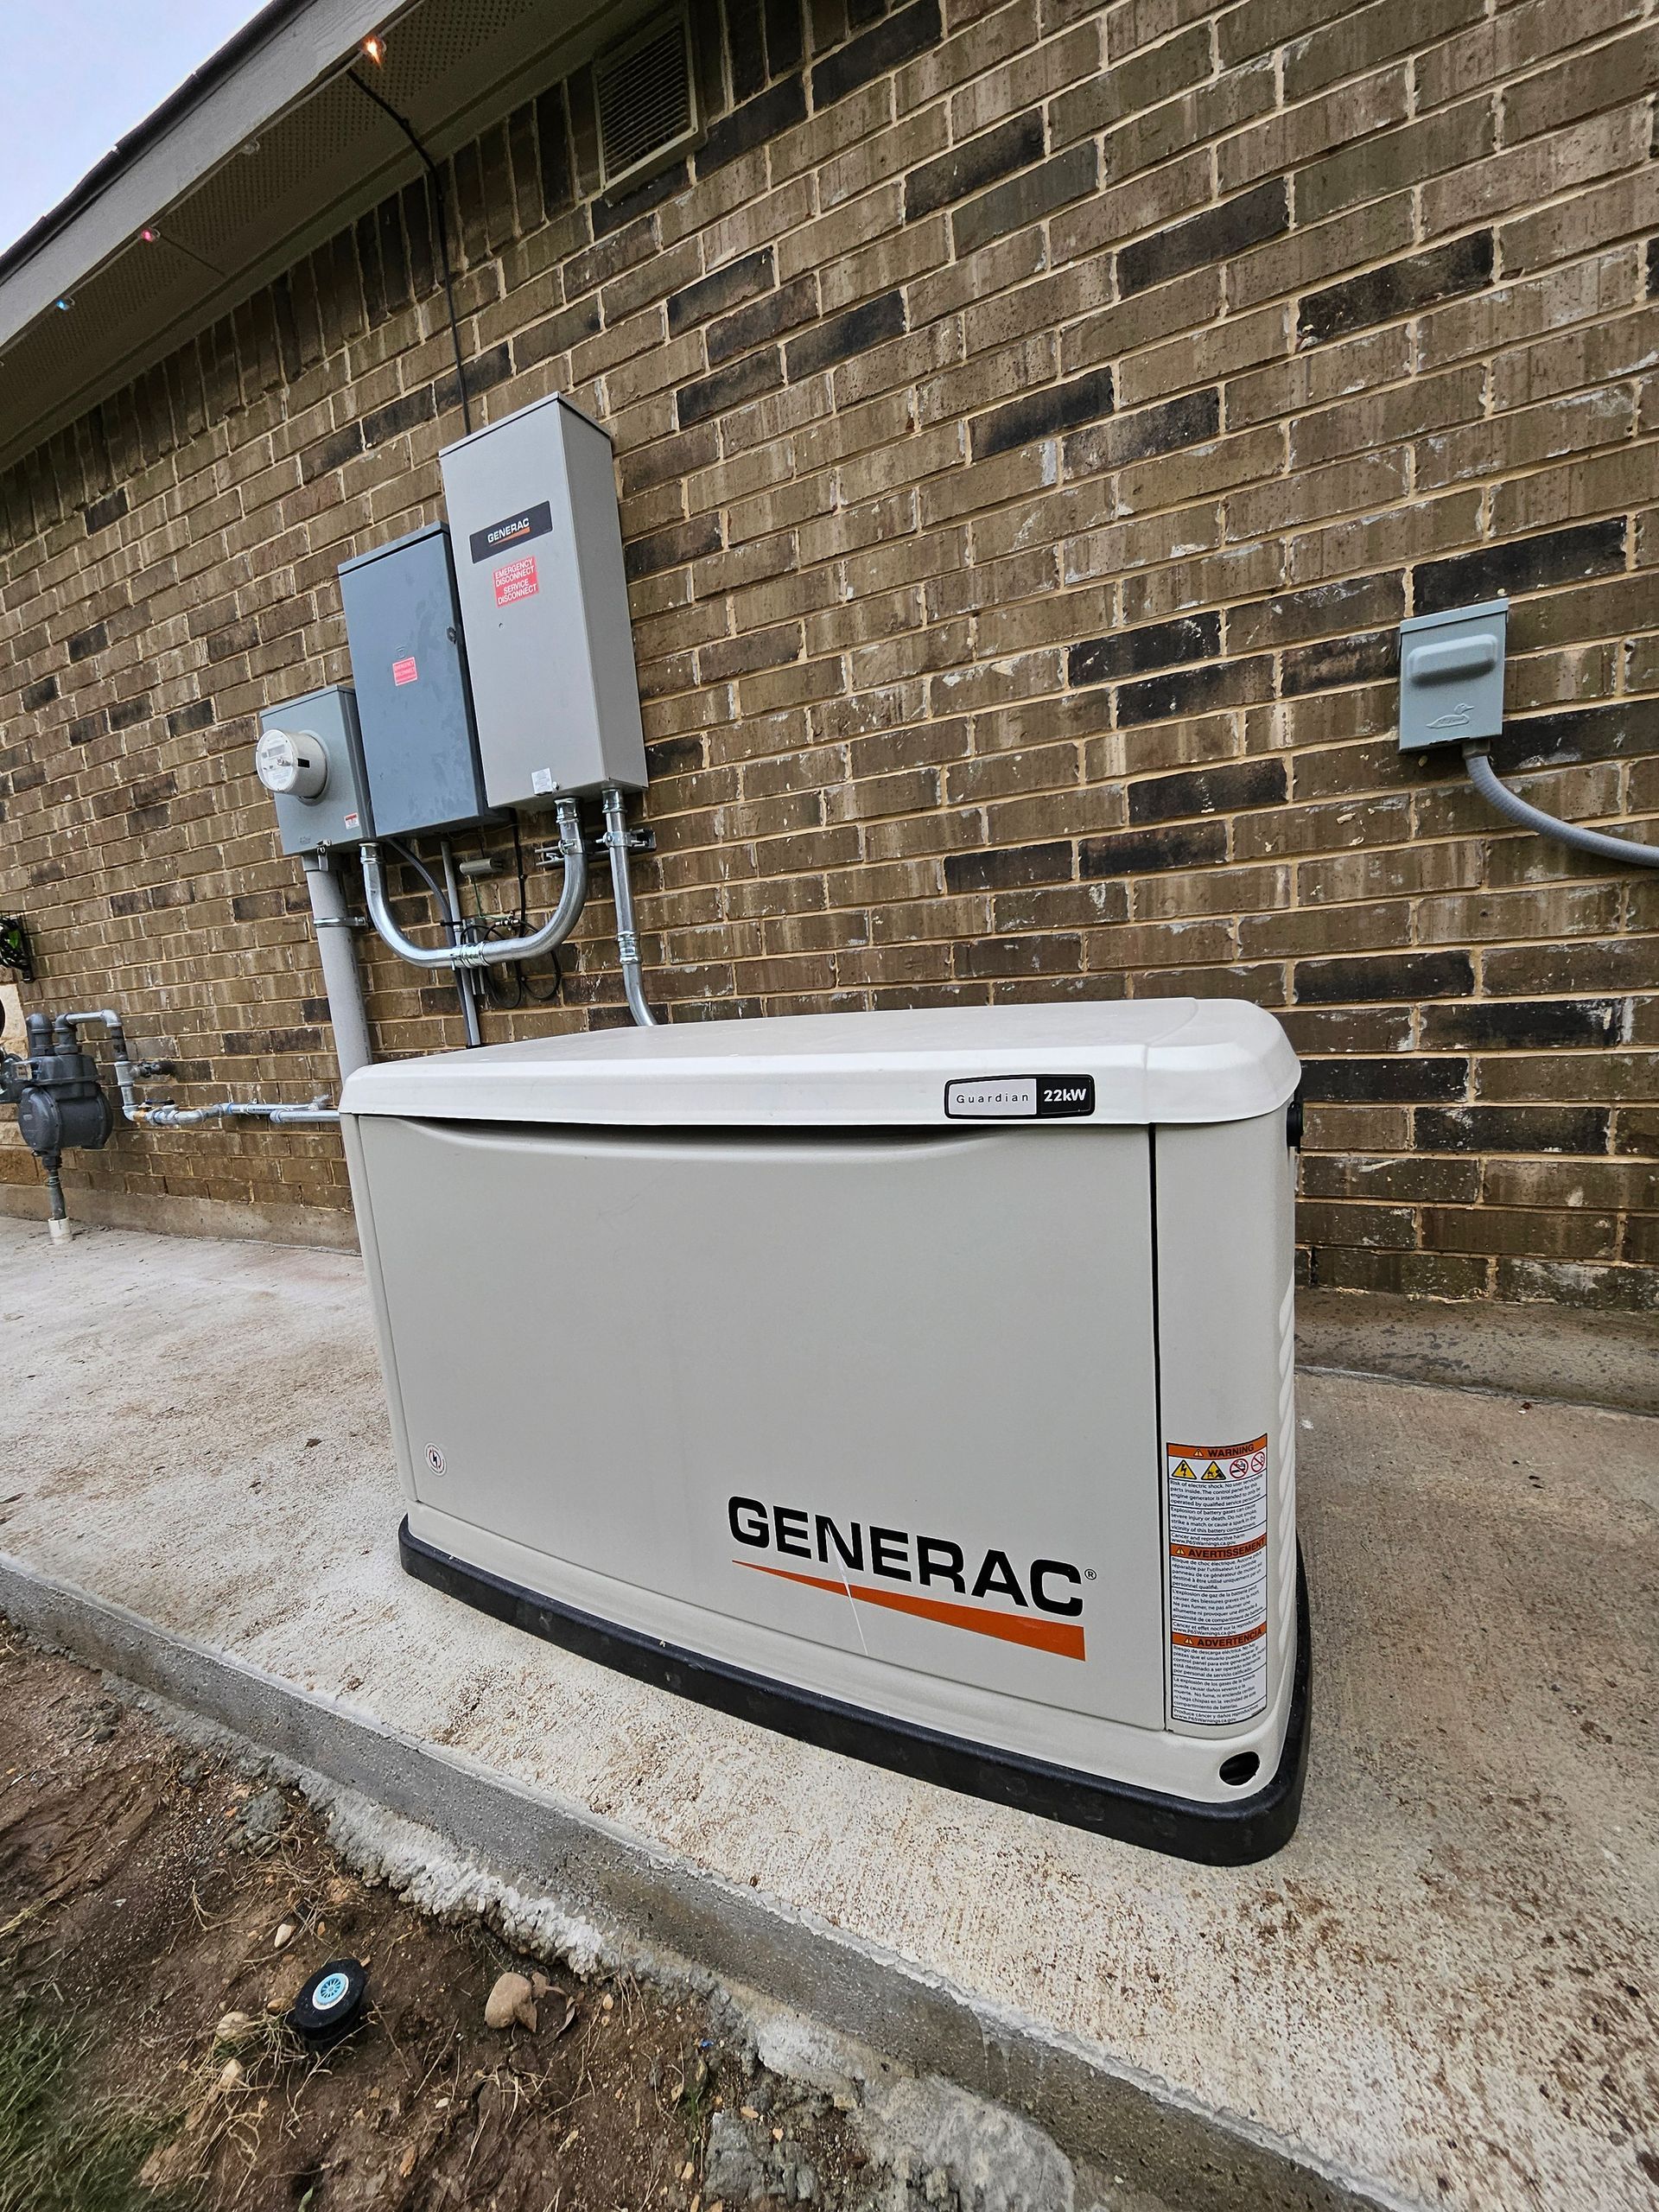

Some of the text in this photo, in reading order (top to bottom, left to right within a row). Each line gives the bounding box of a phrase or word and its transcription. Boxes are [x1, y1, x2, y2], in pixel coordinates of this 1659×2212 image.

[487, 518, 530, 543] GENERAC
[495, 558, 533, 579] EMERGENCY
[496, 566, 535, 588] DISCONNECT
[504, 579, 530, 594] SERVICE
[498, 584, 537, 605] DISCONNECT
[957, 1088, 1087, 1103] Guardian 22kW
[1207, 1444, 1255, 1458] WARNING
[1171, 1498, 1194, 1507] operated
[1171, 1507, 1196, 1516] Explosion
[1233, 1518, 1244, 1527] spark
[1188, 1536, 1265, 1558] AVERTISSEMENT
[1173, 1580, 1198, 1590] personnel
[1197, 1626, 1262, 1647] ADVERTENCIA
[1184, 1669, 1205, 1678] personal
